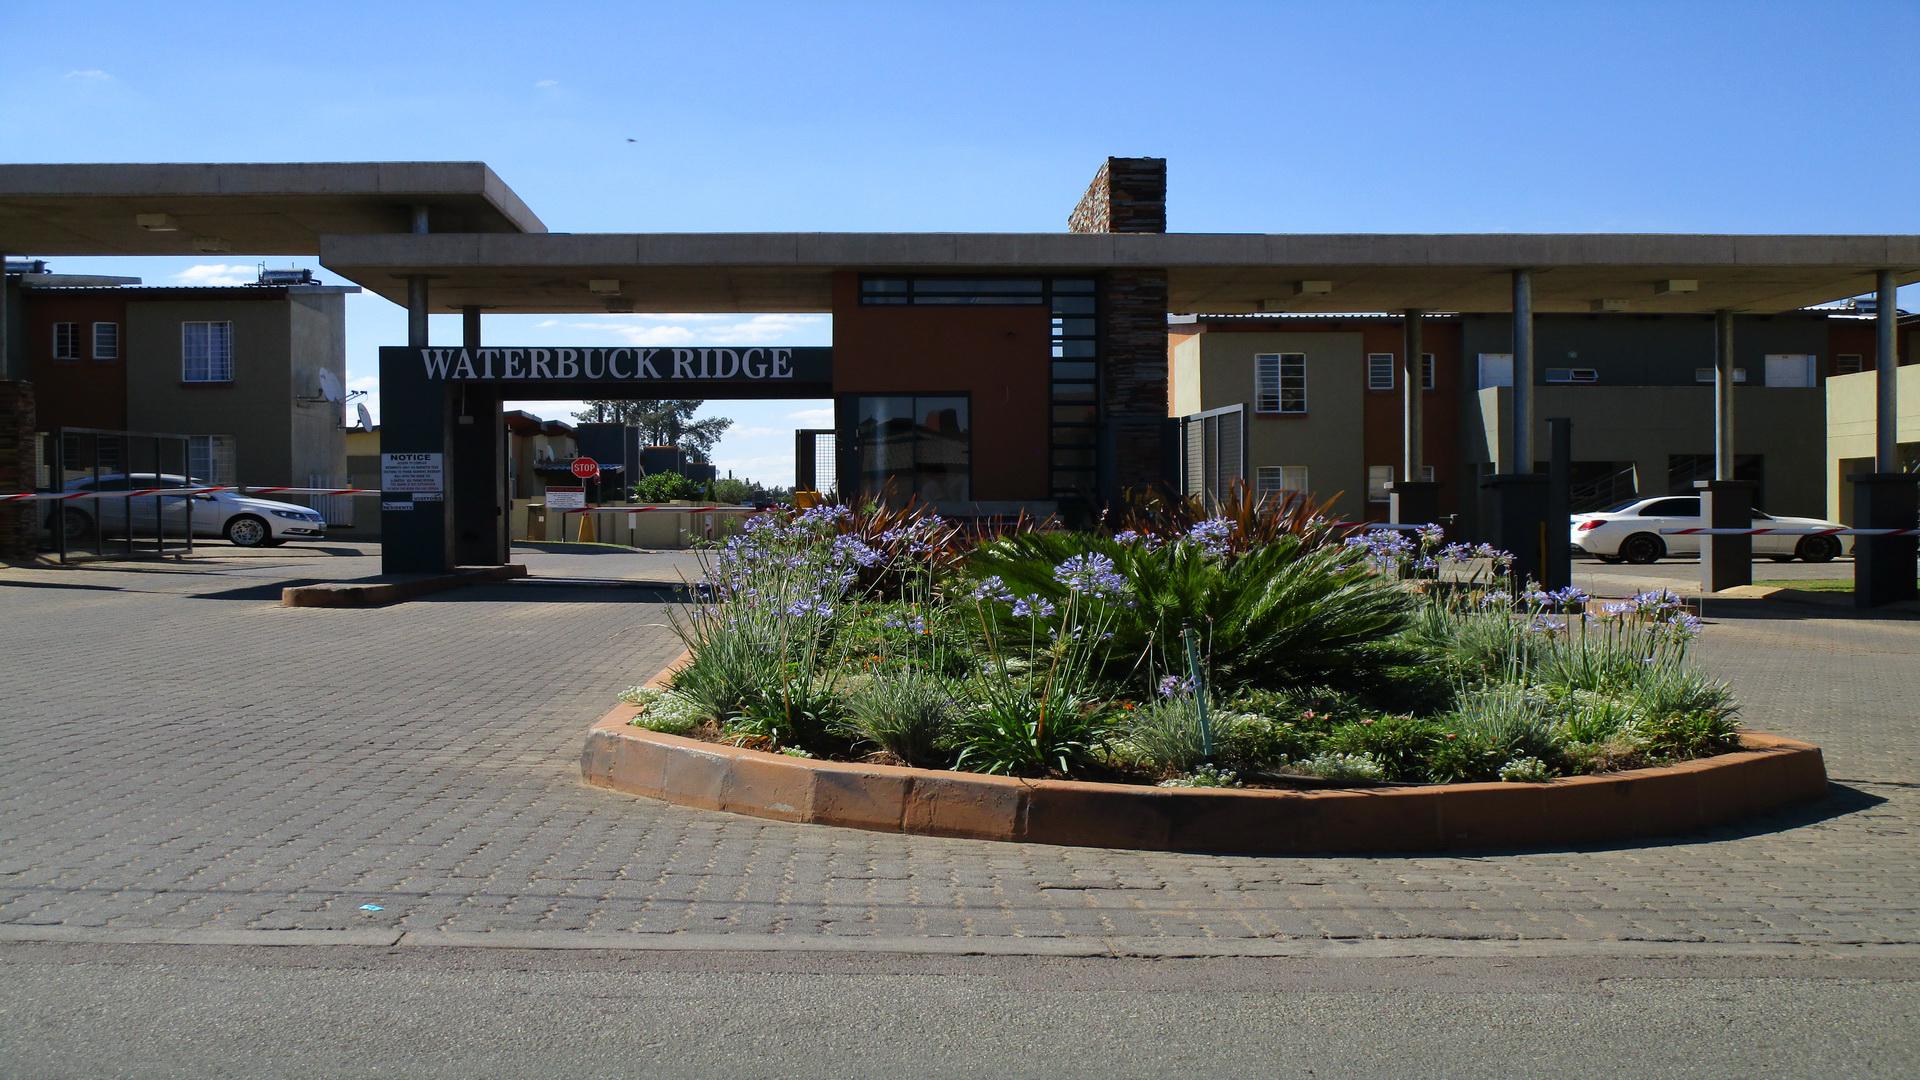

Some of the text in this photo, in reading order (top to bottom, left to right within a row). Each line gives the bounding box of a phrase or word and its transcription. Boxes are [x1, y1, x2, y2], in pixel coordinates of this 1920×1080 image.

[421, 348, 794, 379] WATERBUCK RIDGE
[574, 463, 596, 472] STOP
